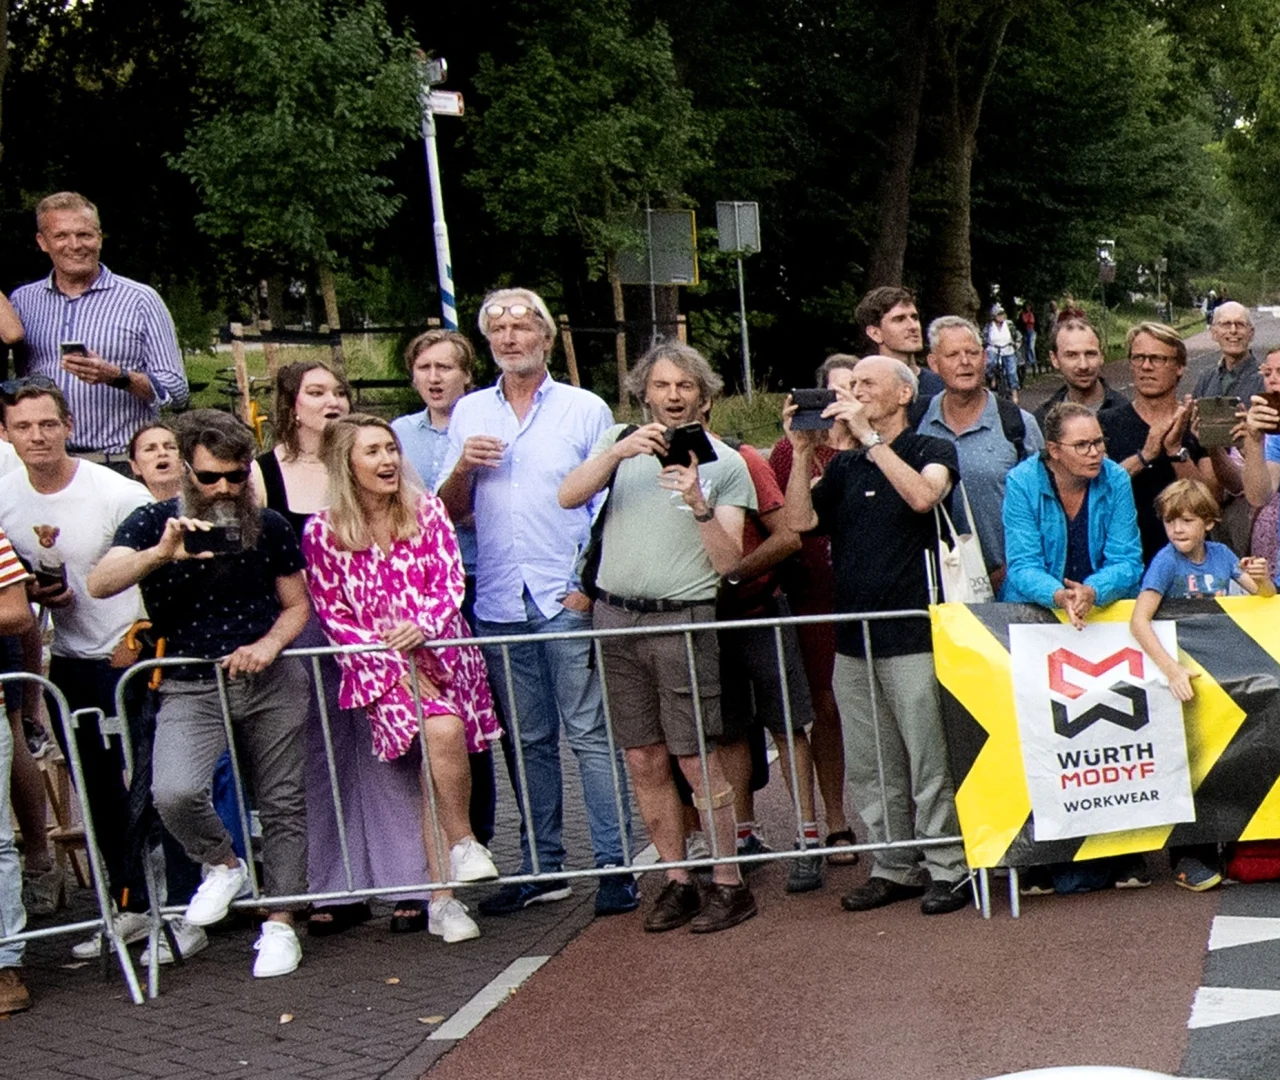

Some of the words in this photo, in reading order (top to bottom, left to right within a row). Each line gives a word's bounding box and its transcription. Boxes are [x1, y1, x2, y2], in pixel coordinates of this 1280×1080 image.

[1057, 742, 1155, 770] WÜRTH
[1061, 762, 1155, 790] MODYF
[1064, 790, 1160, 813] WORKWEAR
